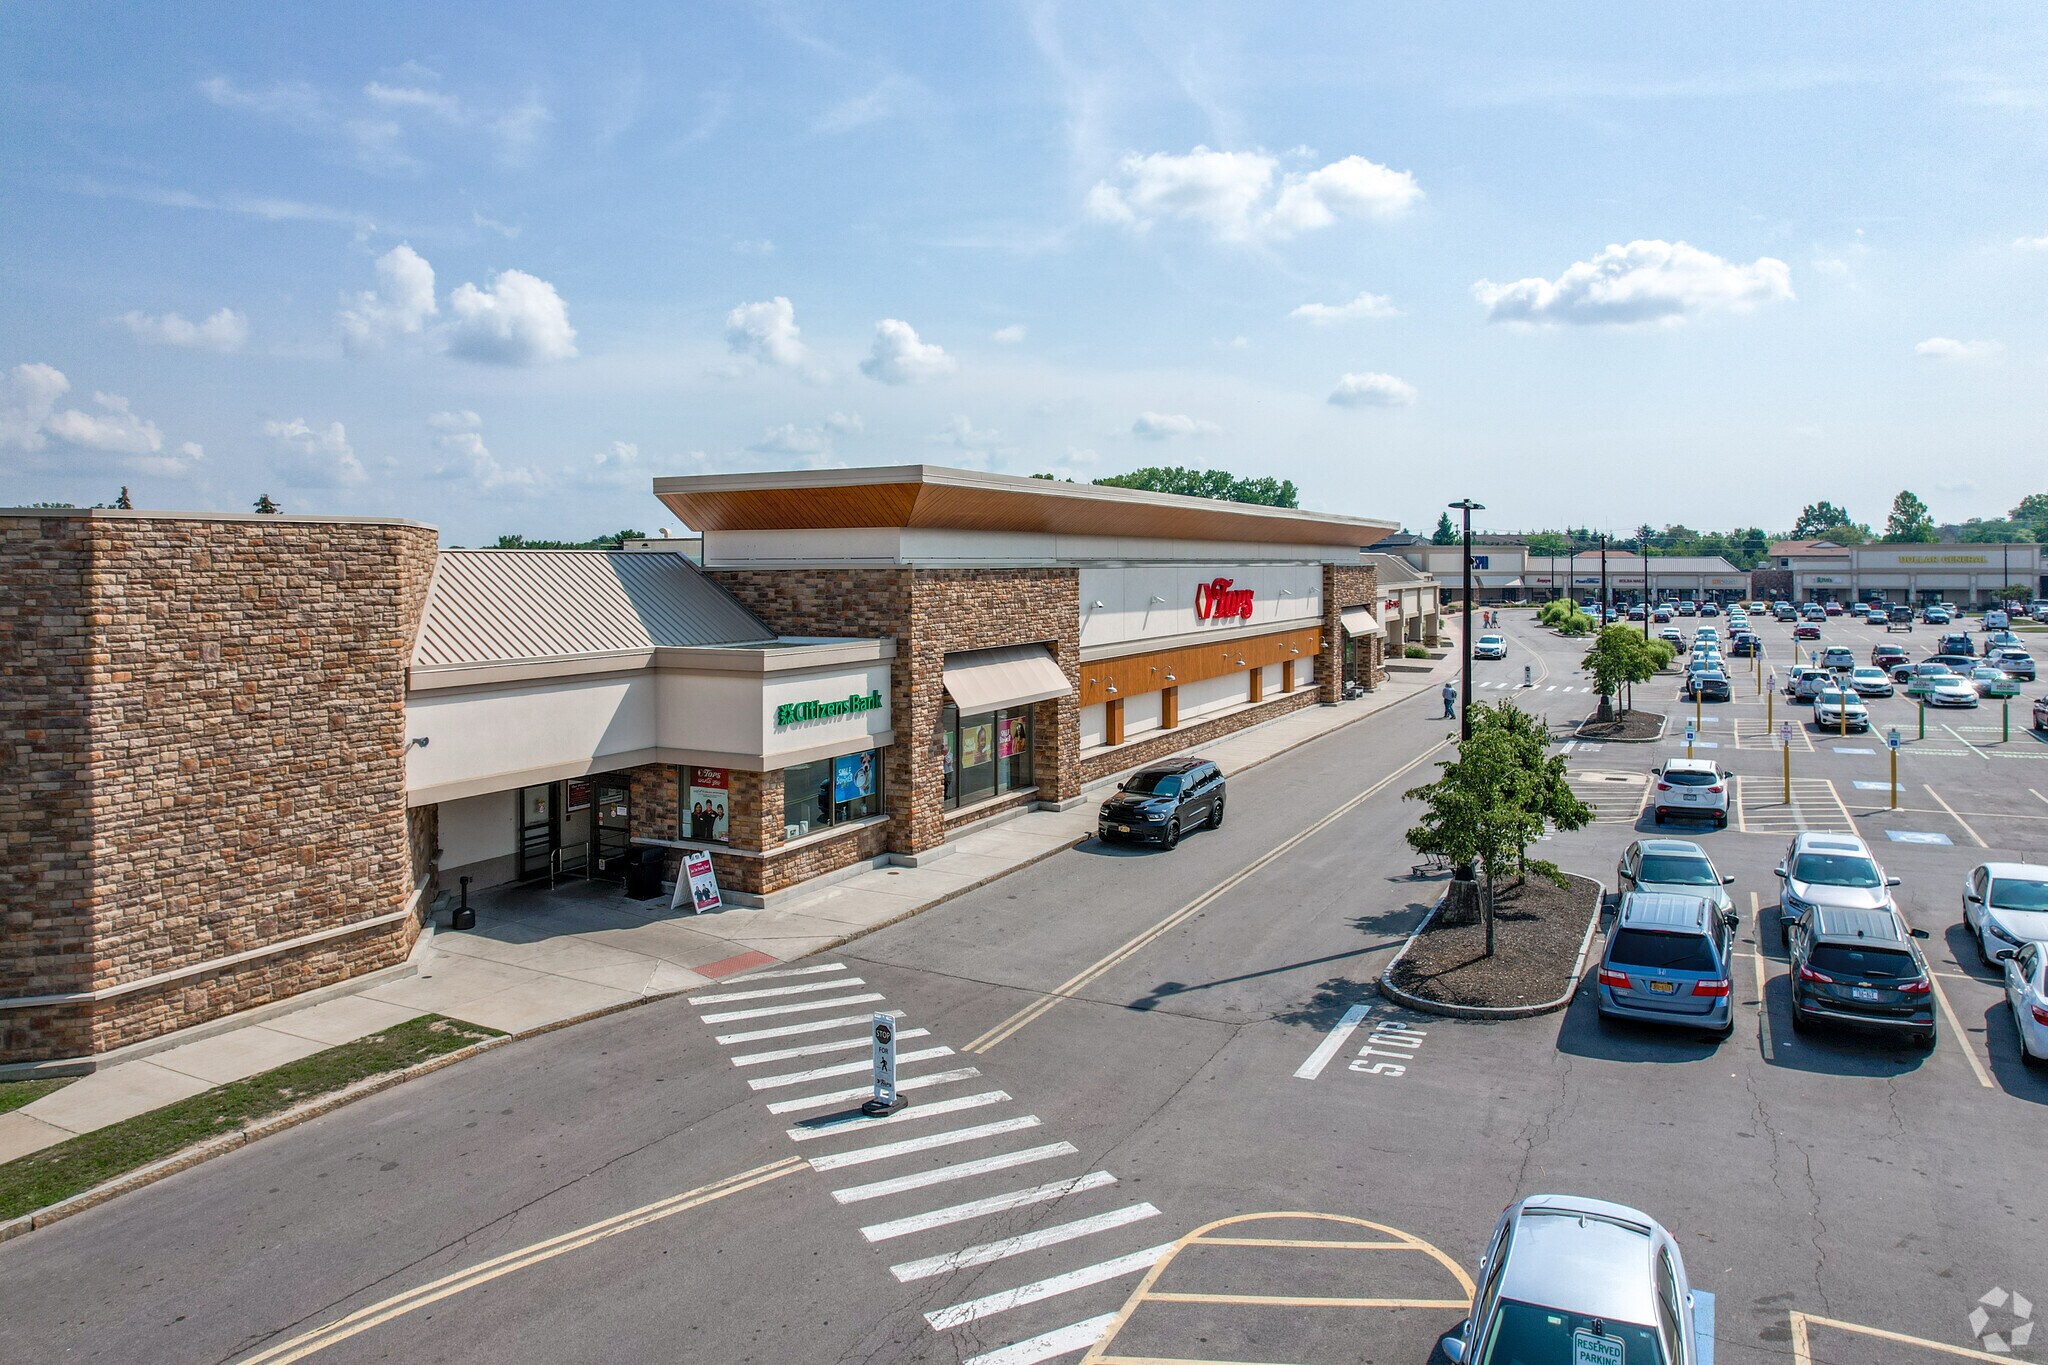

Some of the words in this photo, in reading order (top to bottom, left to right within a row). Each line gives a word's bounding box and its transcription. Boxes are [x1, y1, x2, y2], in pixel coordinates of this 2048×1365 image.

[1898, 556, 1938, 564] DOLLAR
[1940, 556, 1988, 564] GENERAL
[792, 699, 849, 721] Citizens
[849, 690, 883, 713] Bank
[876, 1029, 891, 1039] STOP
[879, 1046, 889, 1055] FOR
[1348, 1020, 1428, 1077] STOP
[1577, 1338, 1621, 1358] RESERVED
[1580, 1351, 1618, 1365] PARKING
